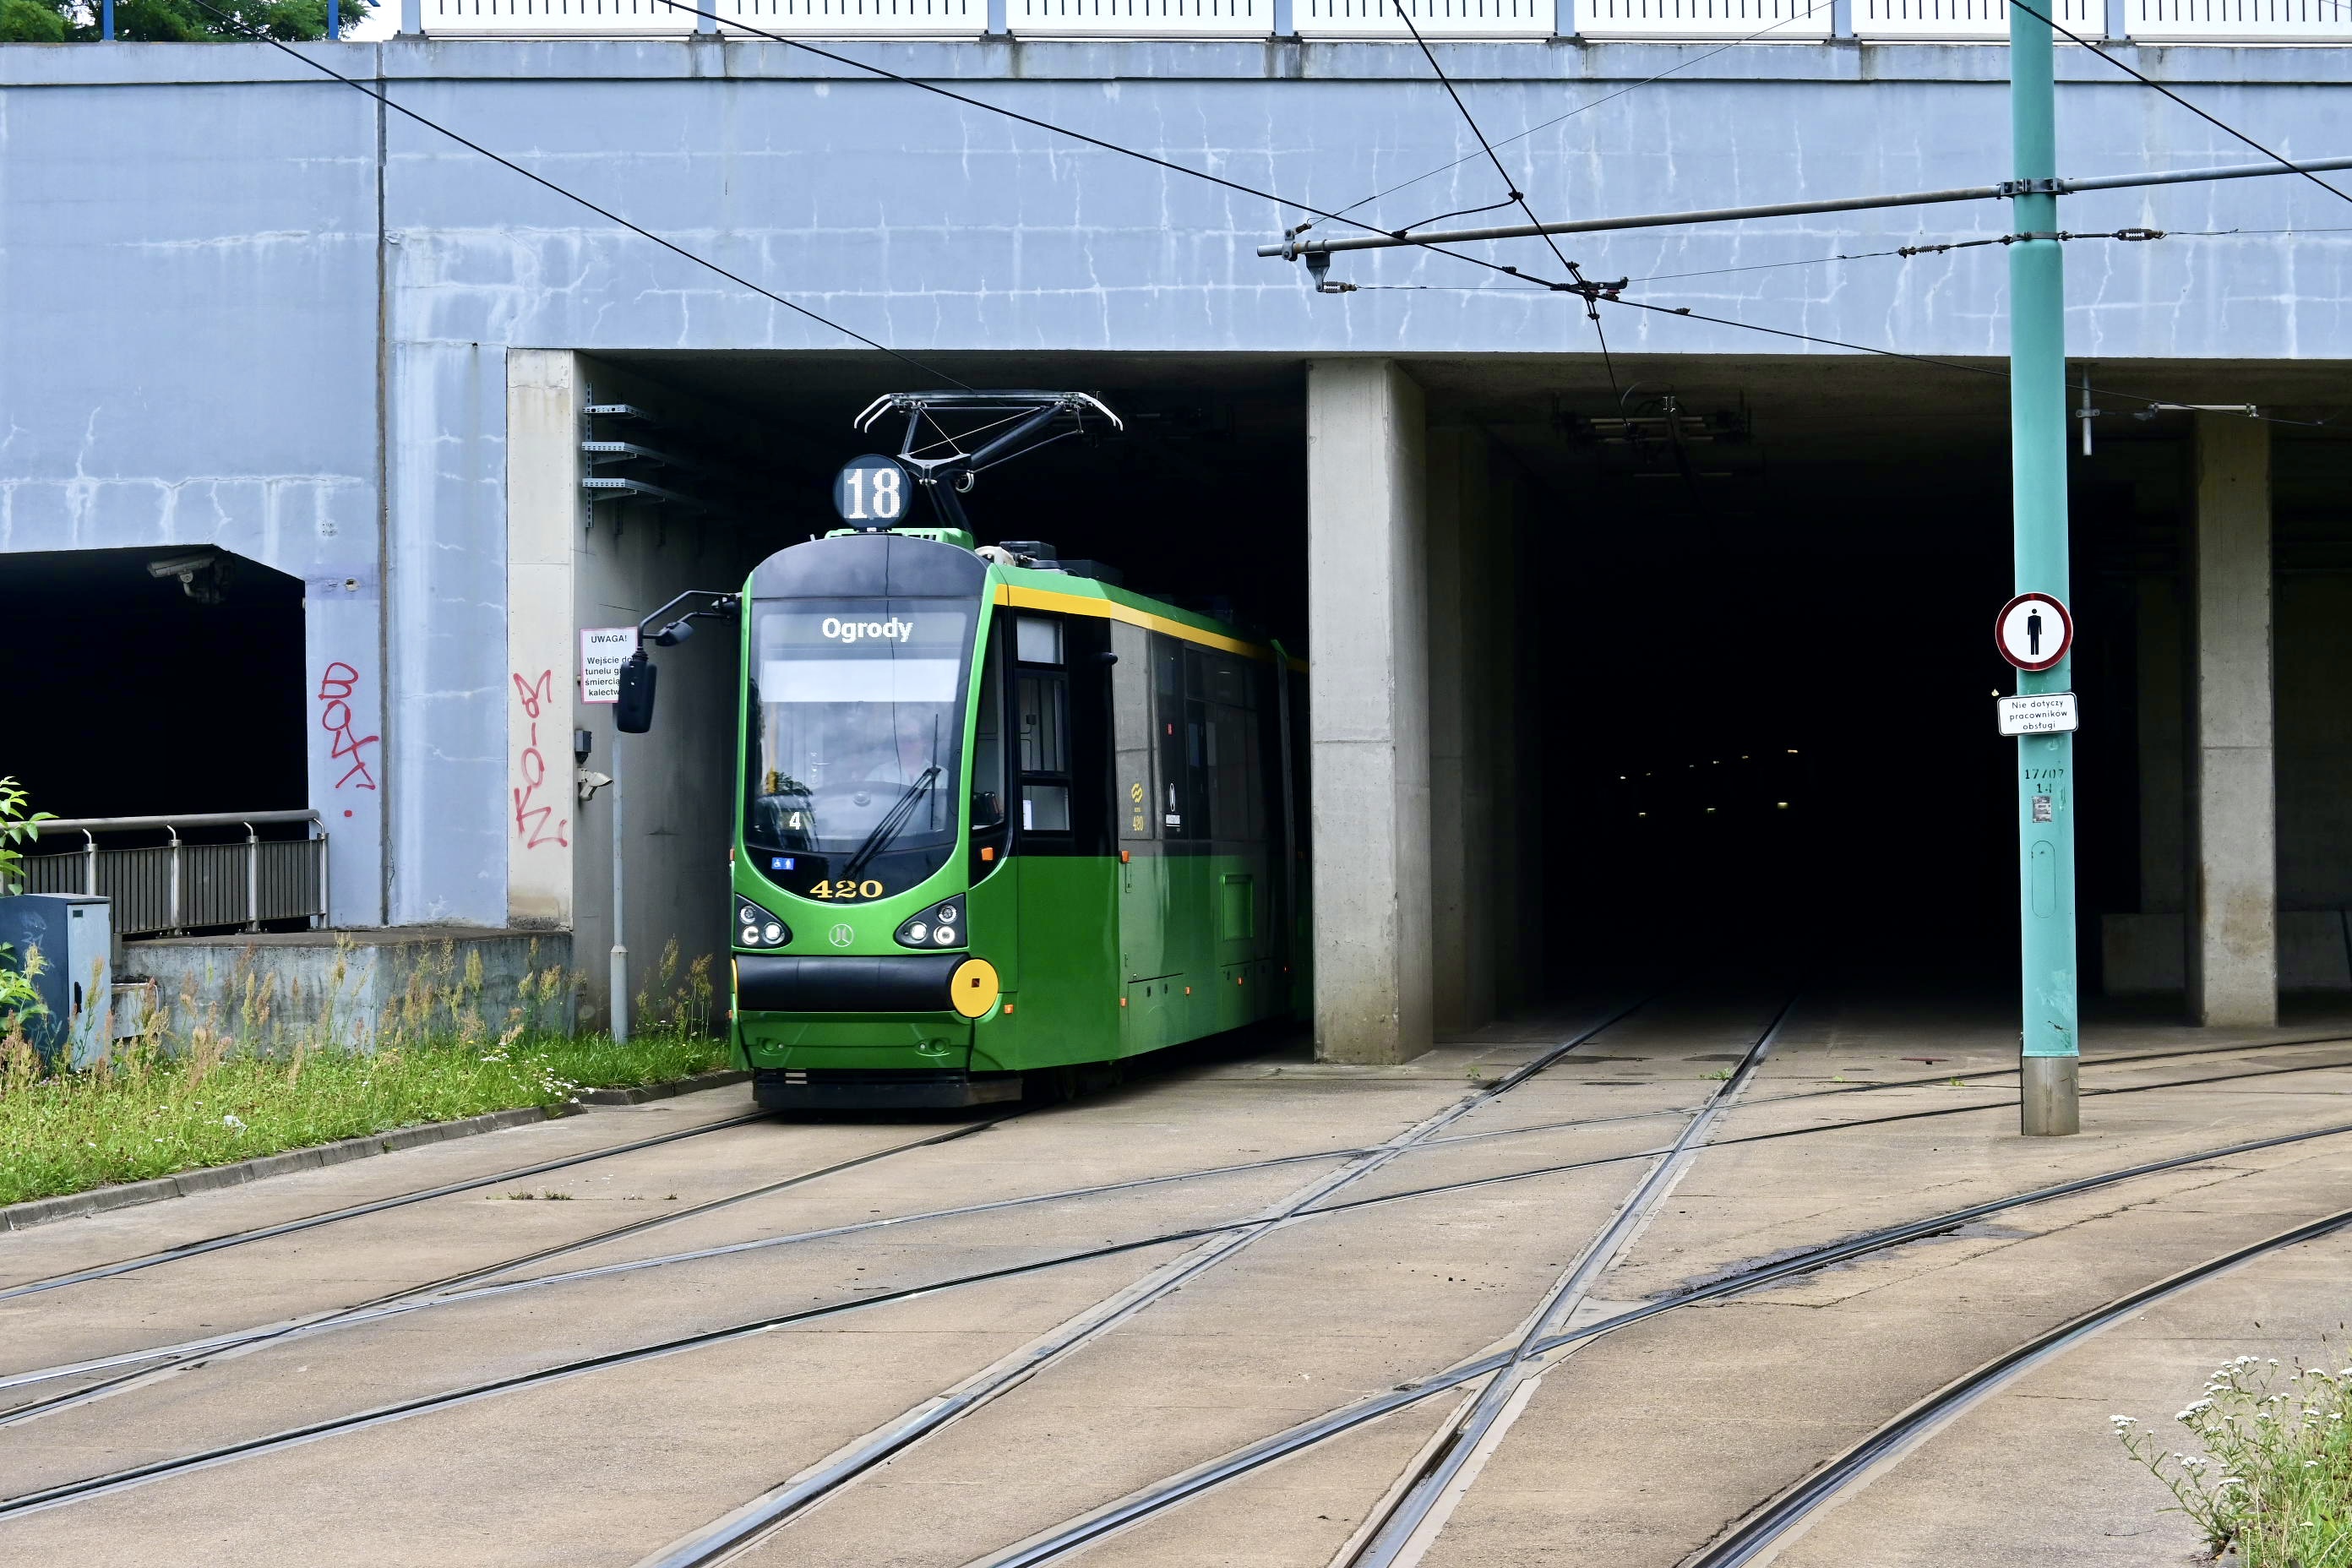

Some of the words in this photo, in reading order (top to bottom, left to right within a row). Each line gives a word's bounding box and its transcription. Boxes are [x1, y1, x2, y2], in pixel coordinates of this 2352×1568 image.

[847, 468, 901, 520] 18
[822, 617, 913, 644] Ogrody
[586, 656, 619, 666] Wejście
[585, 677, 621, 686] śmiercią
[2030, 700, 2064, 709] dotyczy
[2009, 710, 2067, 721] pracowników
[2023, 721, 2056, 731] obsługi
[789, 811, 801, 830] 4
[1132, 815, 1144, 831] 420
[809, 879, 884, 898] 420
